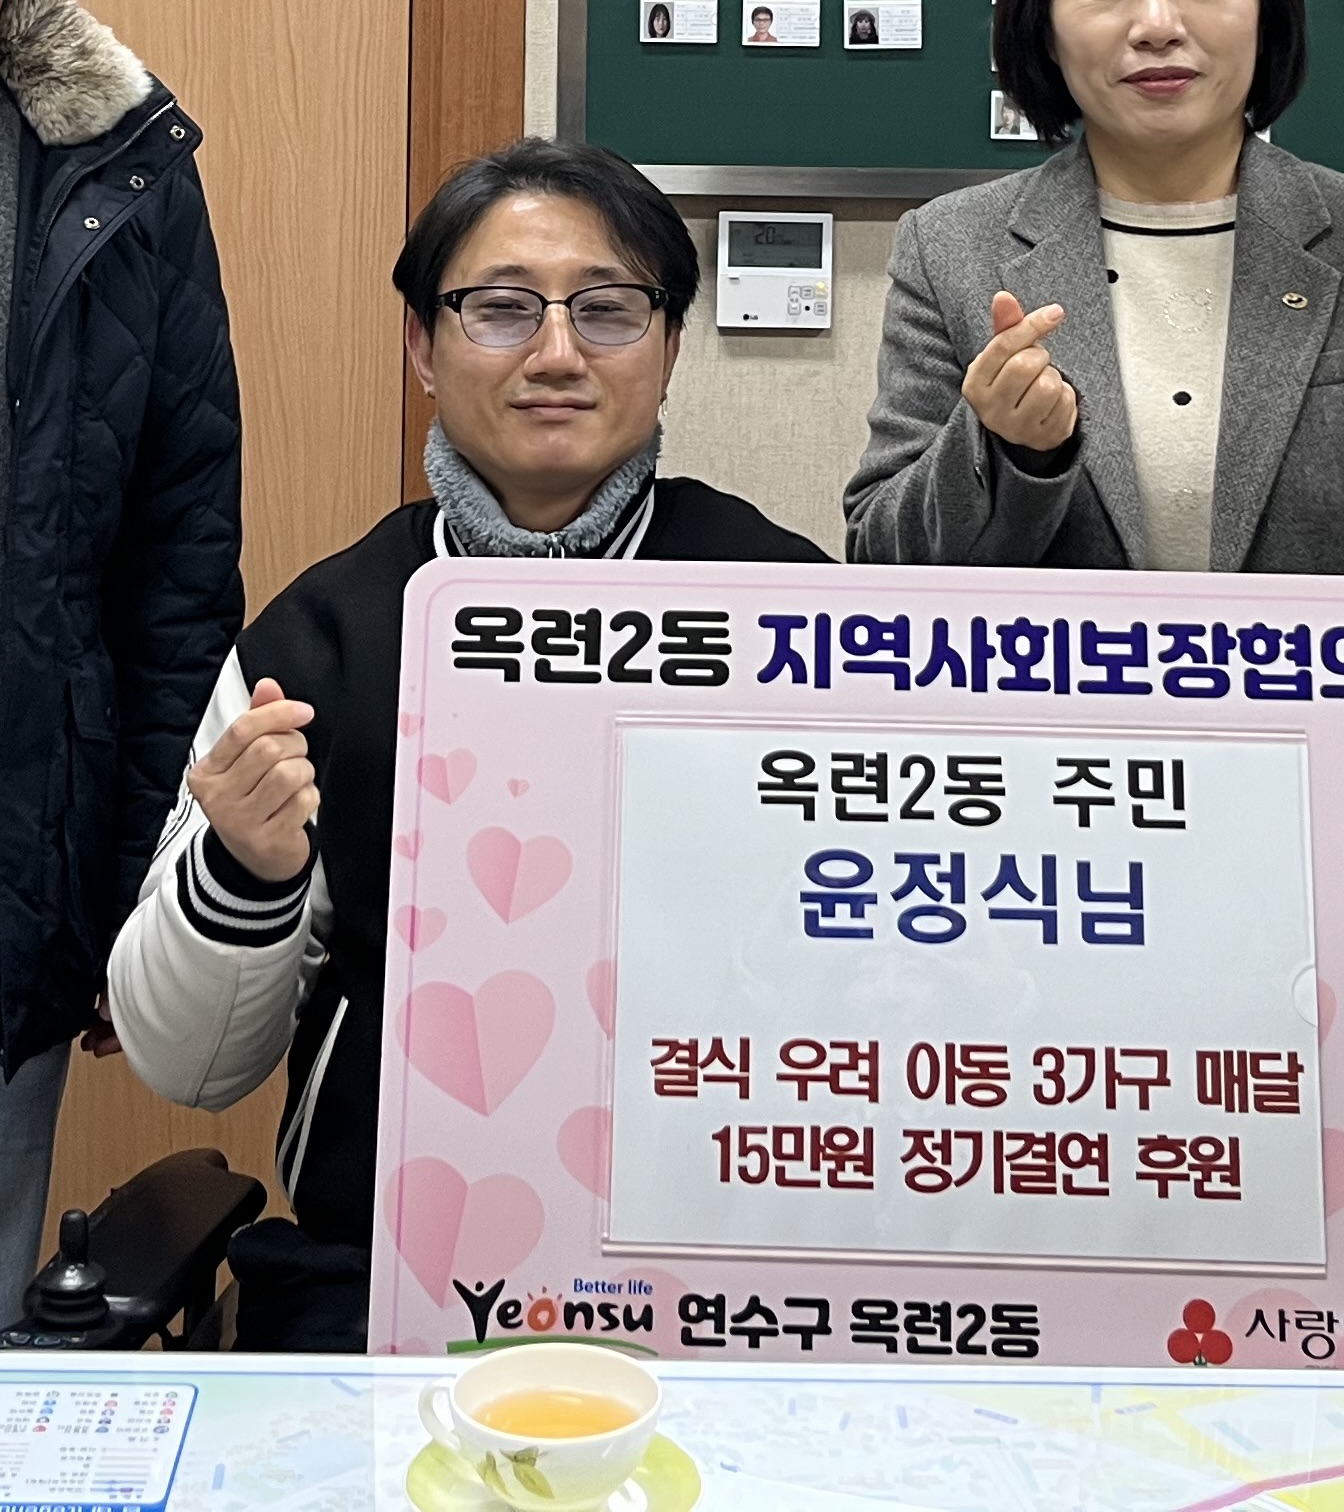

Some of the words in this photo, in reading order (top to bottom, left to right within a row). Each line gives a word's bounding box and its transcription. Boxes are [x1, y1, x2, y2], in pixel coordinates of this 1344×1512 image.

[449, 606, 733, 688] 옥련2동
[754, 752, 1008, 829] 옥련2동
[1052, 754, 1188, 832] 주민
[799, 850, 1148, 948] 윤정식님
[650, 1037, 751, 1102] 결식
[775, 1041, 880, 1104] 우려
[907, 1041, 1010, 1108] 아동
[1032, 1045, 1173, 1113] 3가구
[1197, 1049, 1304, 1117] 매달
[711, 1126, 876, 1192] 15만원
[902, 1131, 1111, 1199] 정기결연
[1136, 1135, 1242, 1202] 후원
[452, 1278, 655, 1344] Yeonsu
[573, 1278, 625, 1295] Better
[628, 1279, 653, 1296] life
[678, 1293, 833, 1349] 연수구
[849, 1299, 1042, 1358] 옥련2동
